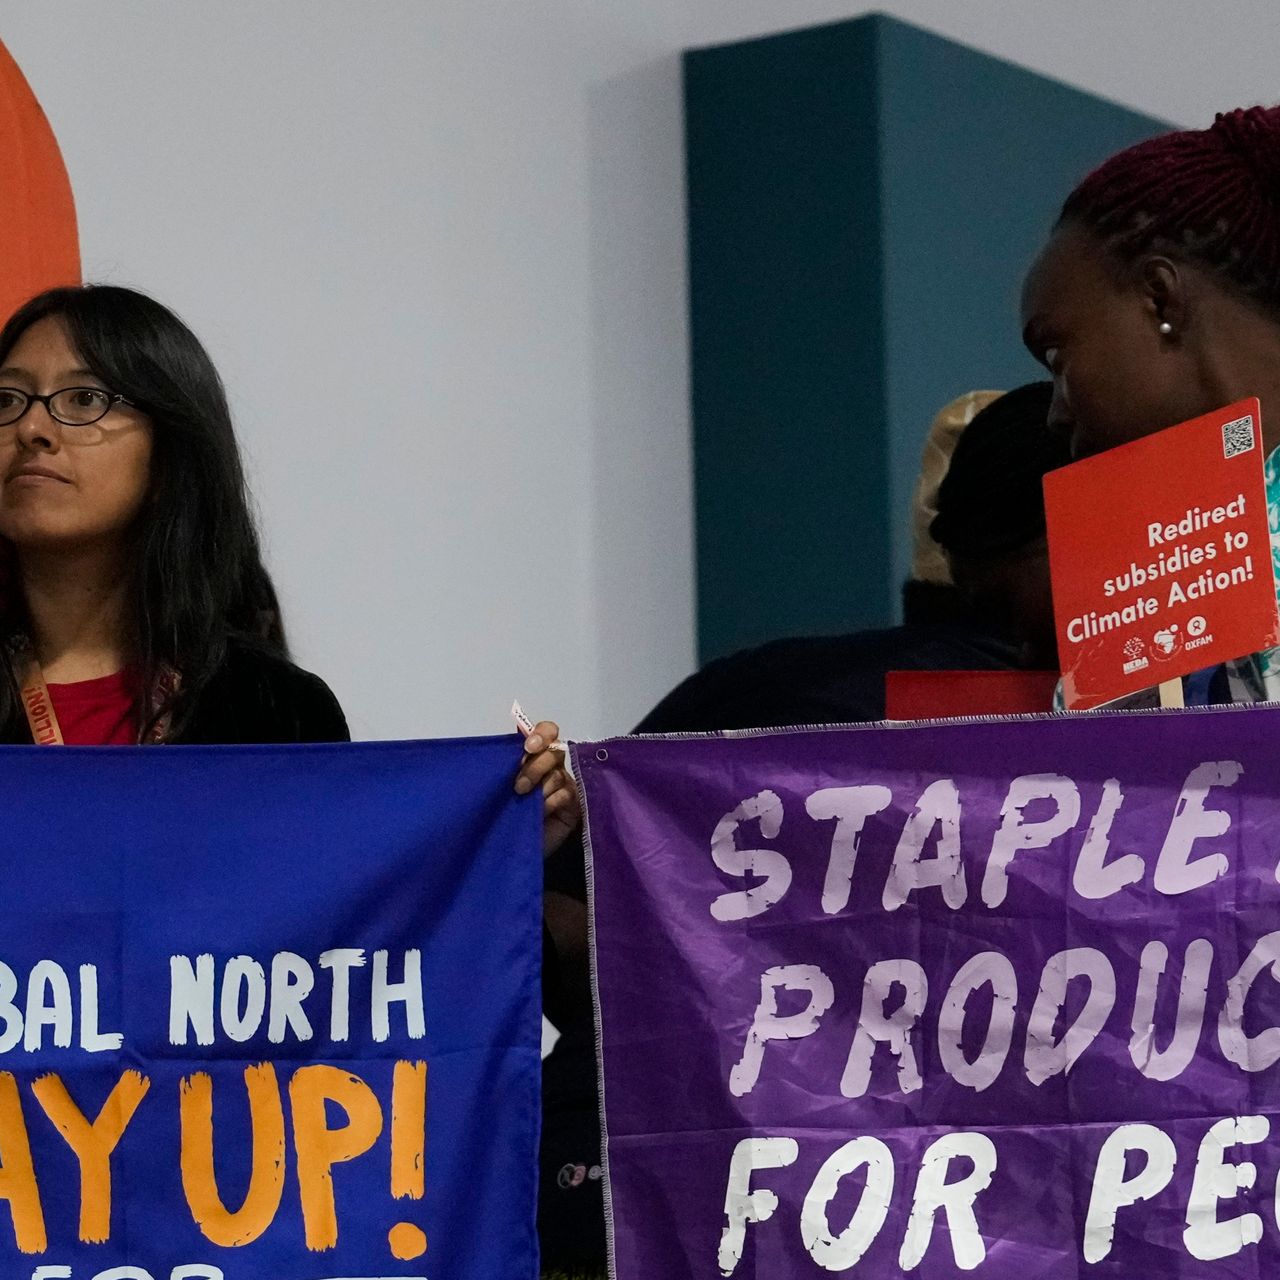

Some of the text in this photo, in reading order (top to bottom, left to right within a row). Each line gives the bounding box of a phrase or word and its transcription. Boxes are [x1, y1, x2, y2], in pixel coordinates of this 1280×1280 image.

[1103, 531, 1249, 597] subsidies to
[1147, 493, 1246, 548] Redirect
[1066, 555, 1254, 643] Climate Action!
[1185, 634, 1213, 651] OXFAM
[710, 760, 1245, 921] STAPLE
[169, 948, 425, 1046] NORTH
[179, 1058, 428, 1261] UP!
[717, 1114, 1280, 1278] FOR PE
